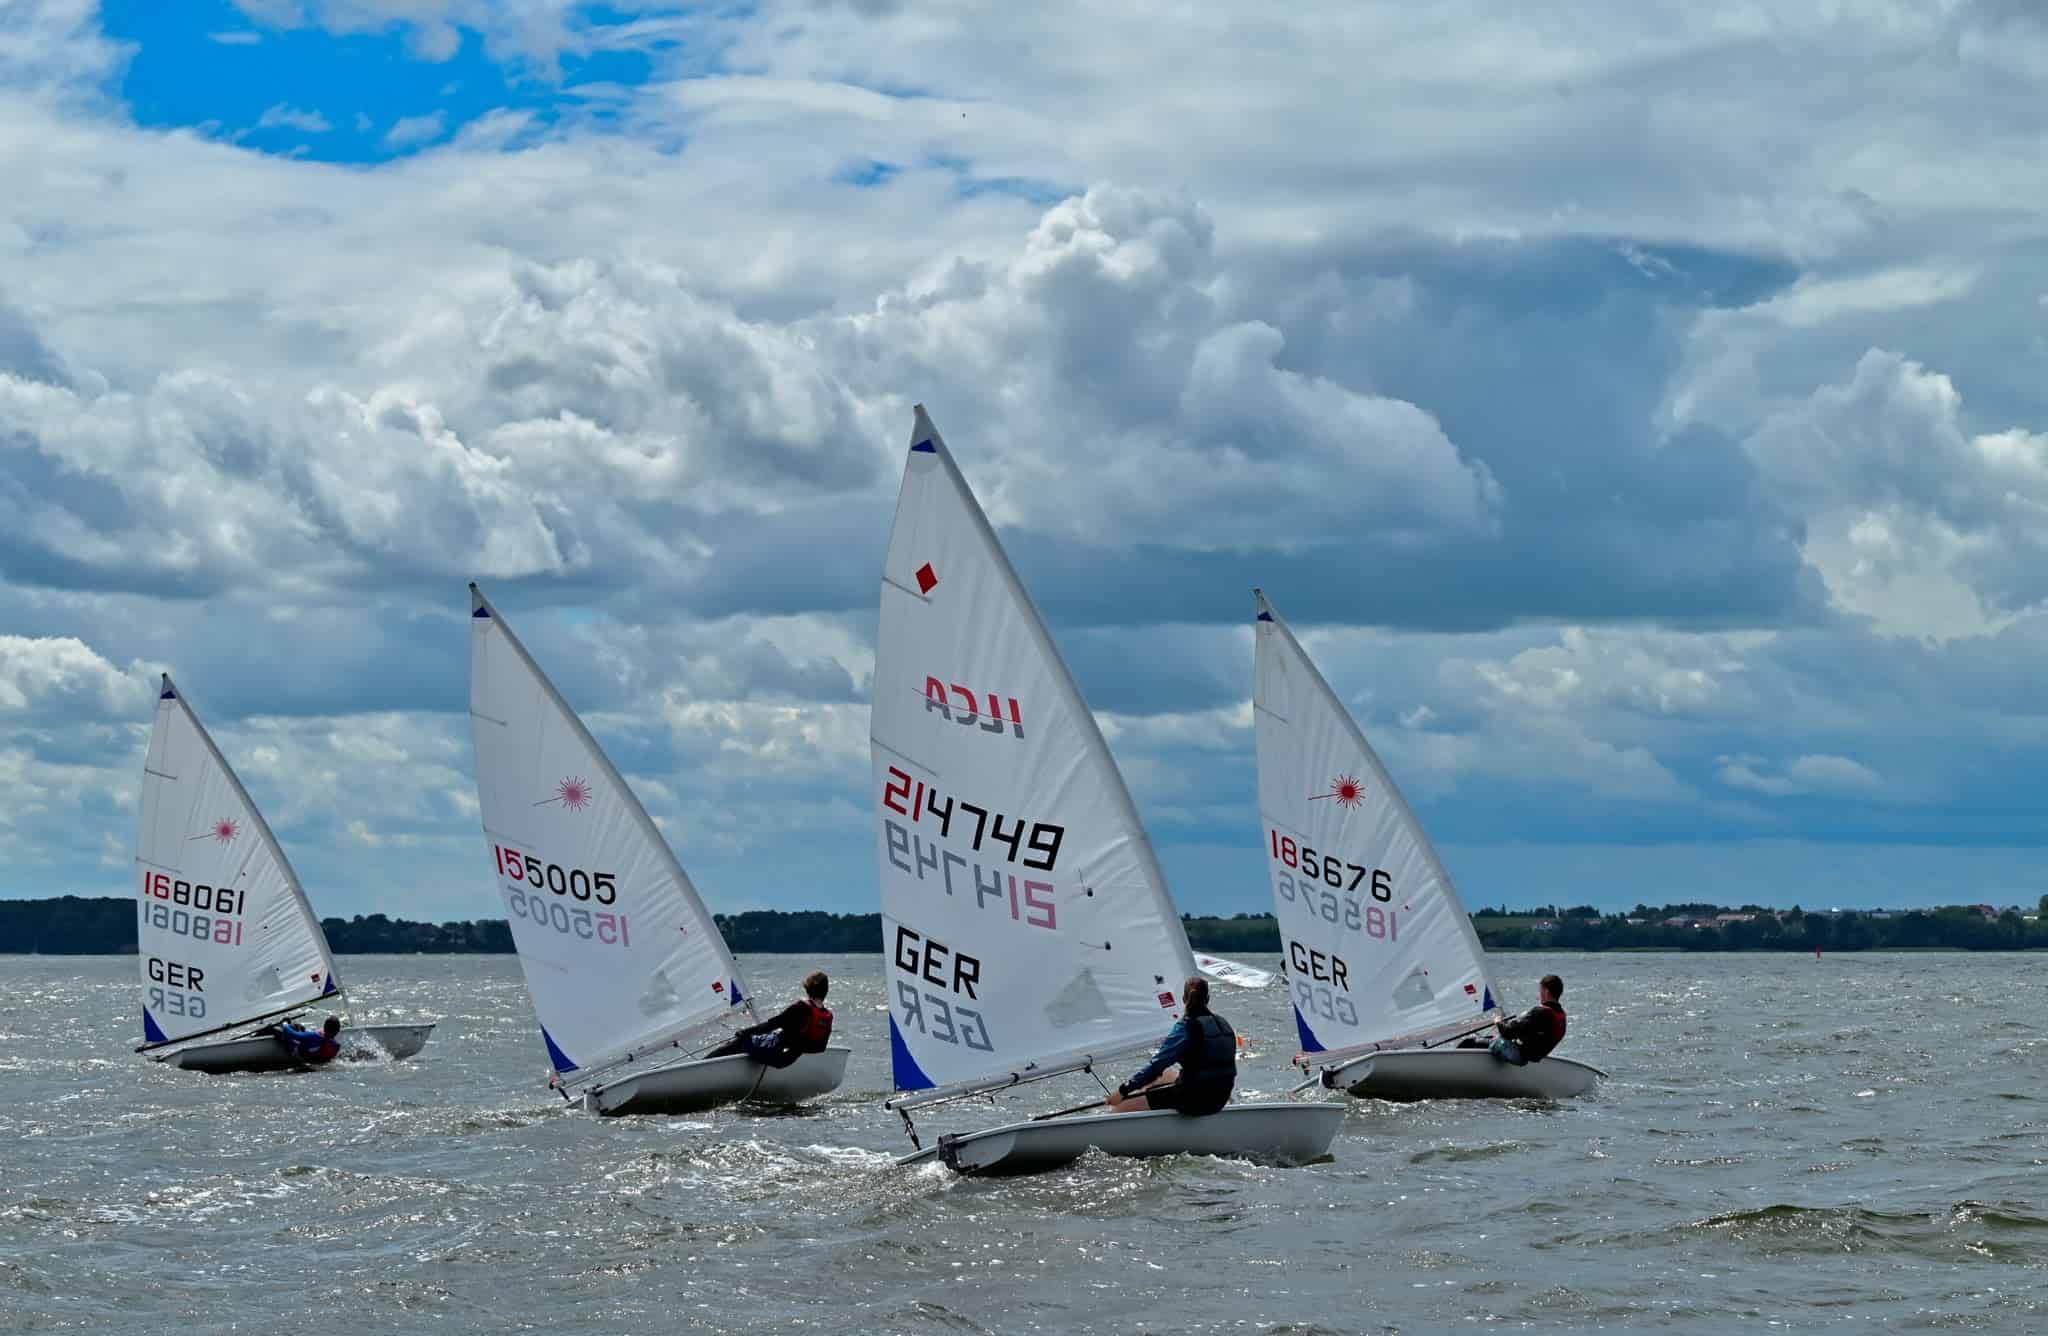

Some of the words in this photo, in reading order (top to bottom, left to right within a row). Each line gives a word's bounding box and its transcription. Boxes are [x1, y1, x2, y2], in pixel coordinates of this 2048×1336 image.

[884, 766, 1064, 871] 214749
[145, 871, 245, 915] 168061
[495, 845, 616, 905] 155005
[1272, 830, 1392, 902] 185676
[149, 958, 204, 992] GER
[895, 925, 980, 1000] GER
[1290, 941, 1349, 992] GER
